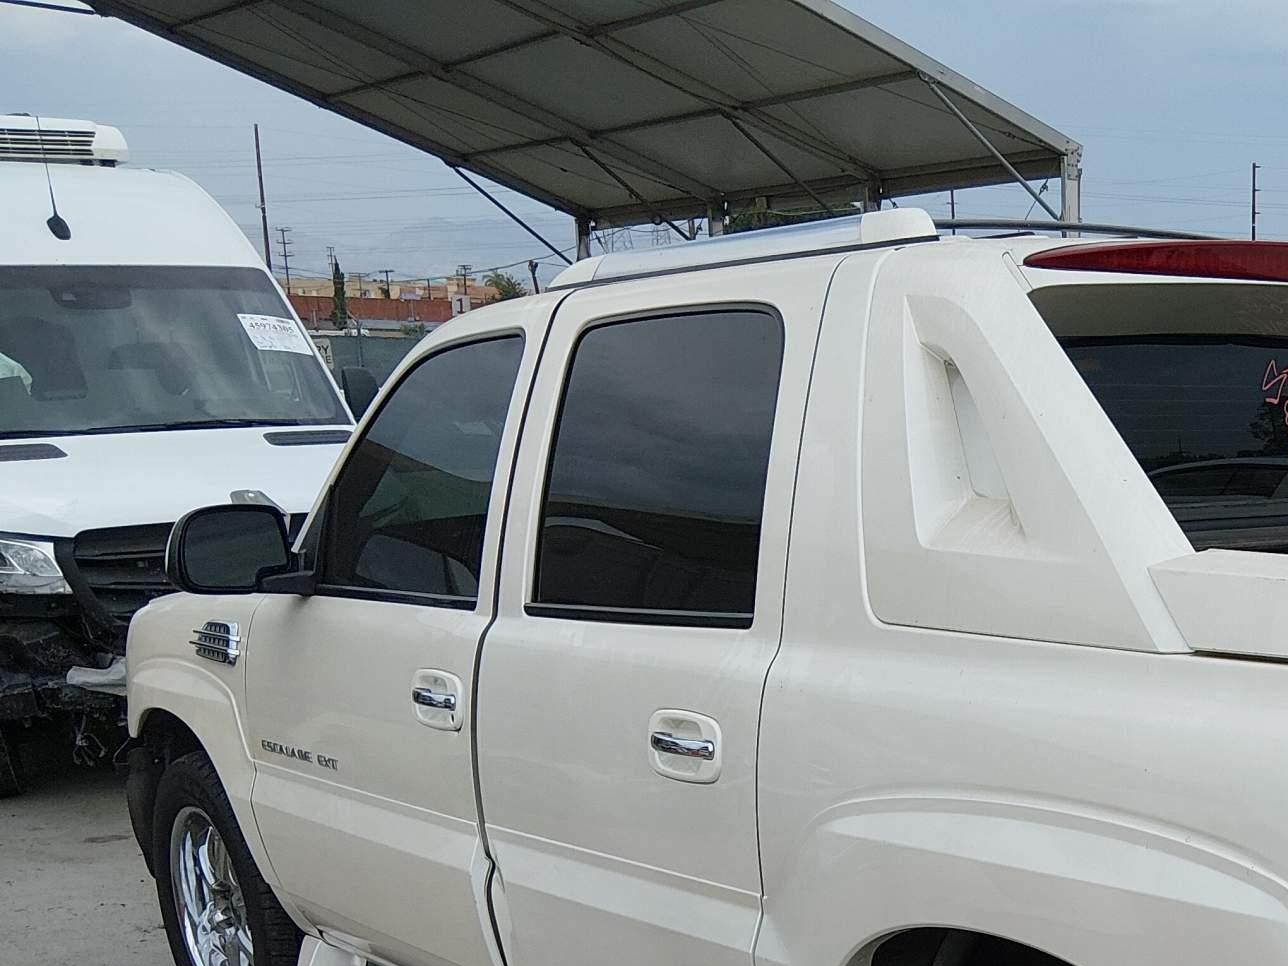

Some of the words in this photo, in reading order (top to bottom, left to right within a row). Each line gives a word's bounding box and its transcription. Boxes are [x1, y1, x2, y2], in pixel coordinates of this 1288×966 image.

[456, 298, 466, 315] 1
[261, 739, 313, 763] ESCALADE
[317, 754, 338, 770] EXT
